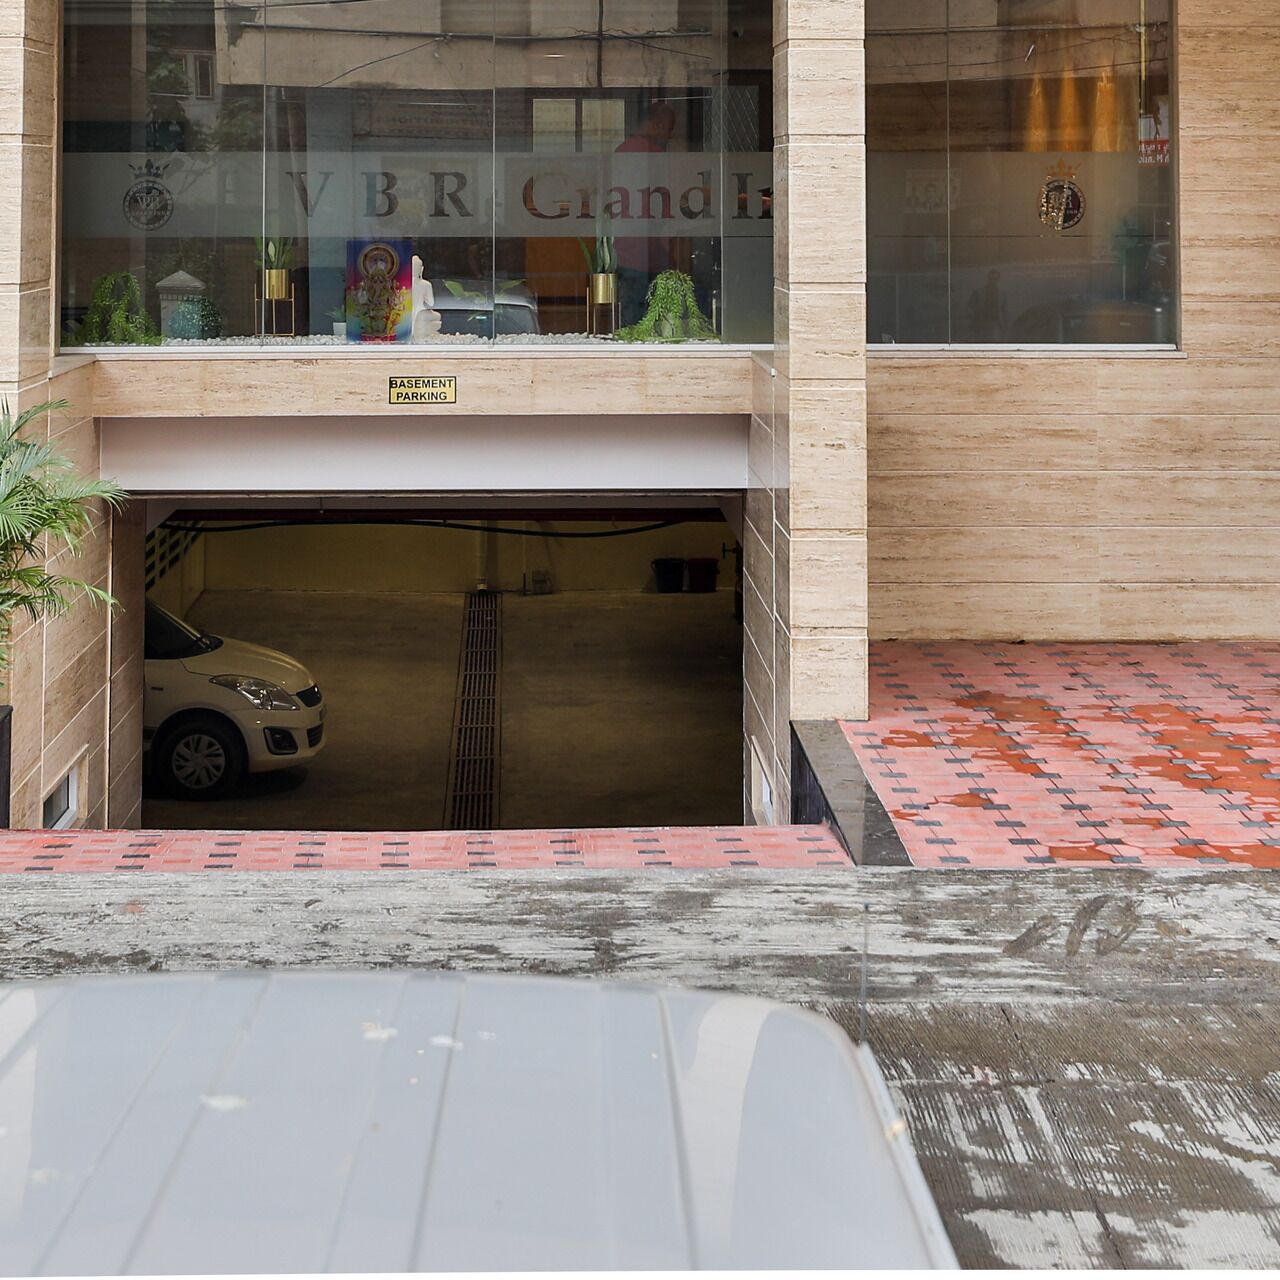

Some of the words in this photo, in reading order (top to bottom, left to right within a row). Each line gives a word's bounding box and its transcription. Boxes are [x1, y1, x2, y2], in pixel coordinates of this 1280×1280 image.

[285, 170, 474, 218] VBR
[521, 170, 717, 219] Grand
[390, 379, 454, 389] BASEMENT
[396, 391, 448, 401] PARKING
